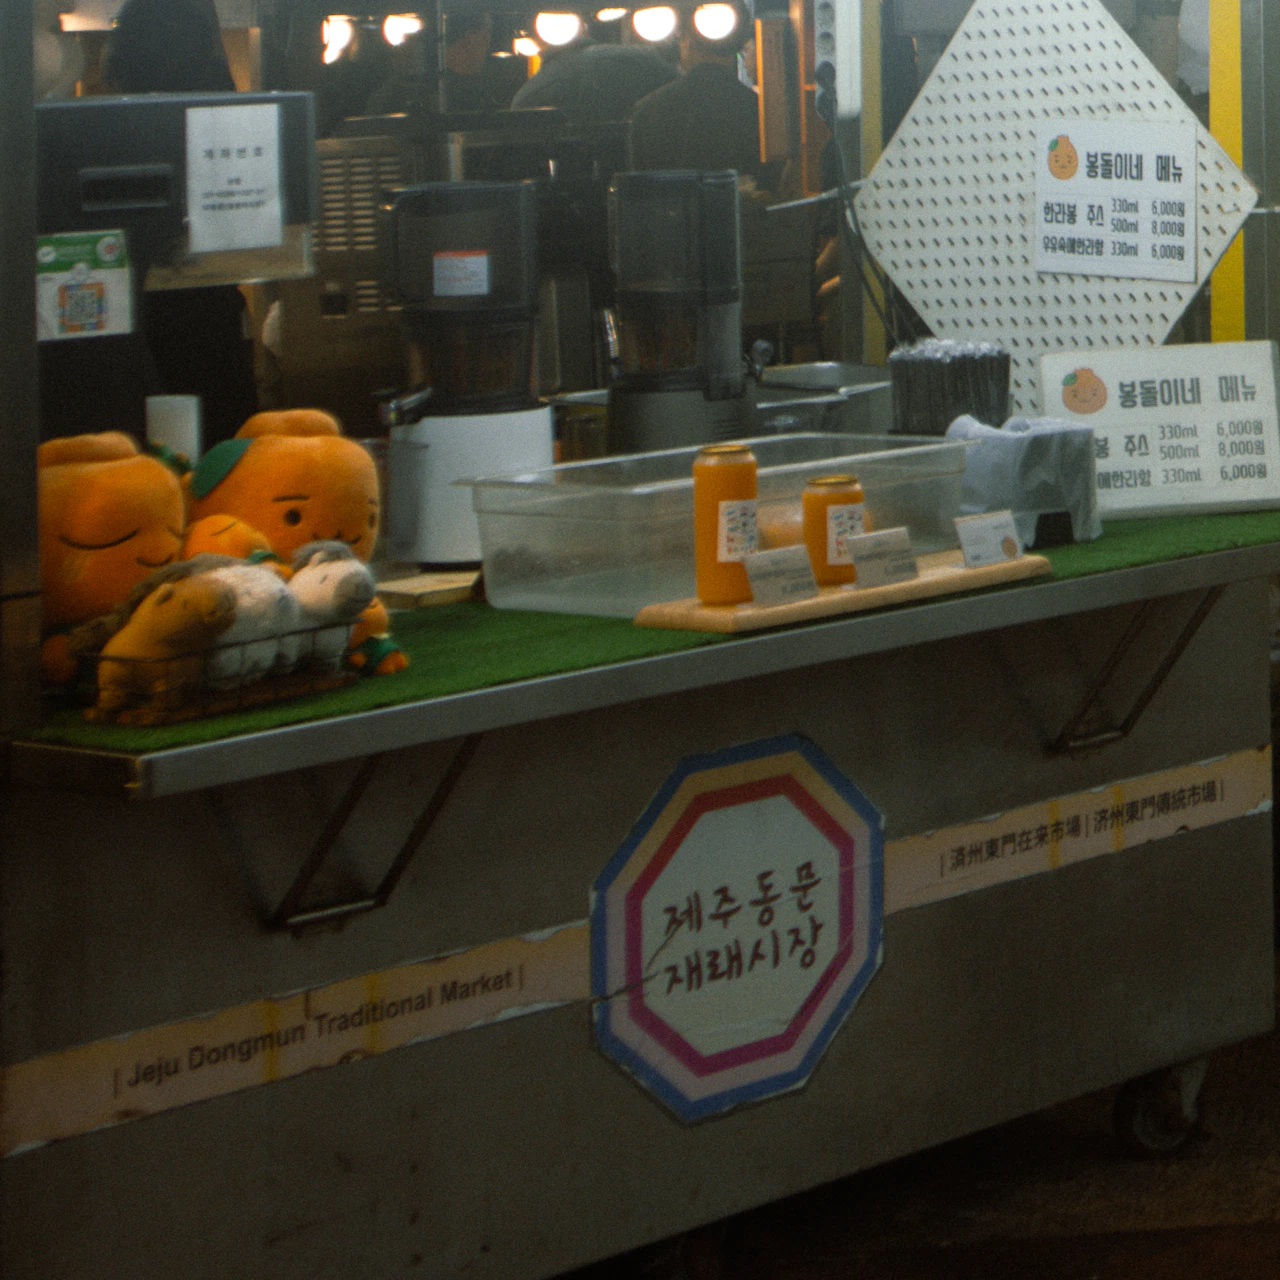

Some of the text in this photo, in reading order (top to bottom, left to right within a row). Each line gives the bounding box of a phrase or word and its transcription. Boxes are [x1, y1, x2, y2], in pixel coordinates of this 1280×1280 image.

[1086, 151, 1183, 183] 봉돌이네 메뉴
[1043, 201, 1077, 225] 한라봉
[1087, 204, 1104, 227] 주스
[1111, 197, 1139, 214] 330ml
[1111, 217, 1139, 234] 500ml
[1111, 241, 1139, 257] 330ml
[1118, 374, 1257, 409] 봉돌이네 메뉴
[1124, 434, 1150, 457] 주스
[1158, 423, 1199, 441] 330ml
[1216, 420, 1263, 439] 6,000원
[1159, 439, 1266, 461] 500ml 8,000원
[1162, 467, 1202, 485] 330ml
[1220, 463, 1268, 482] 6,000원
[664, 861, 823, 936] 제주동문
[664, 918, 825, 996] 재래시장
[127, 968, 513, 1088] Jeju Dongmun Traditional Market
